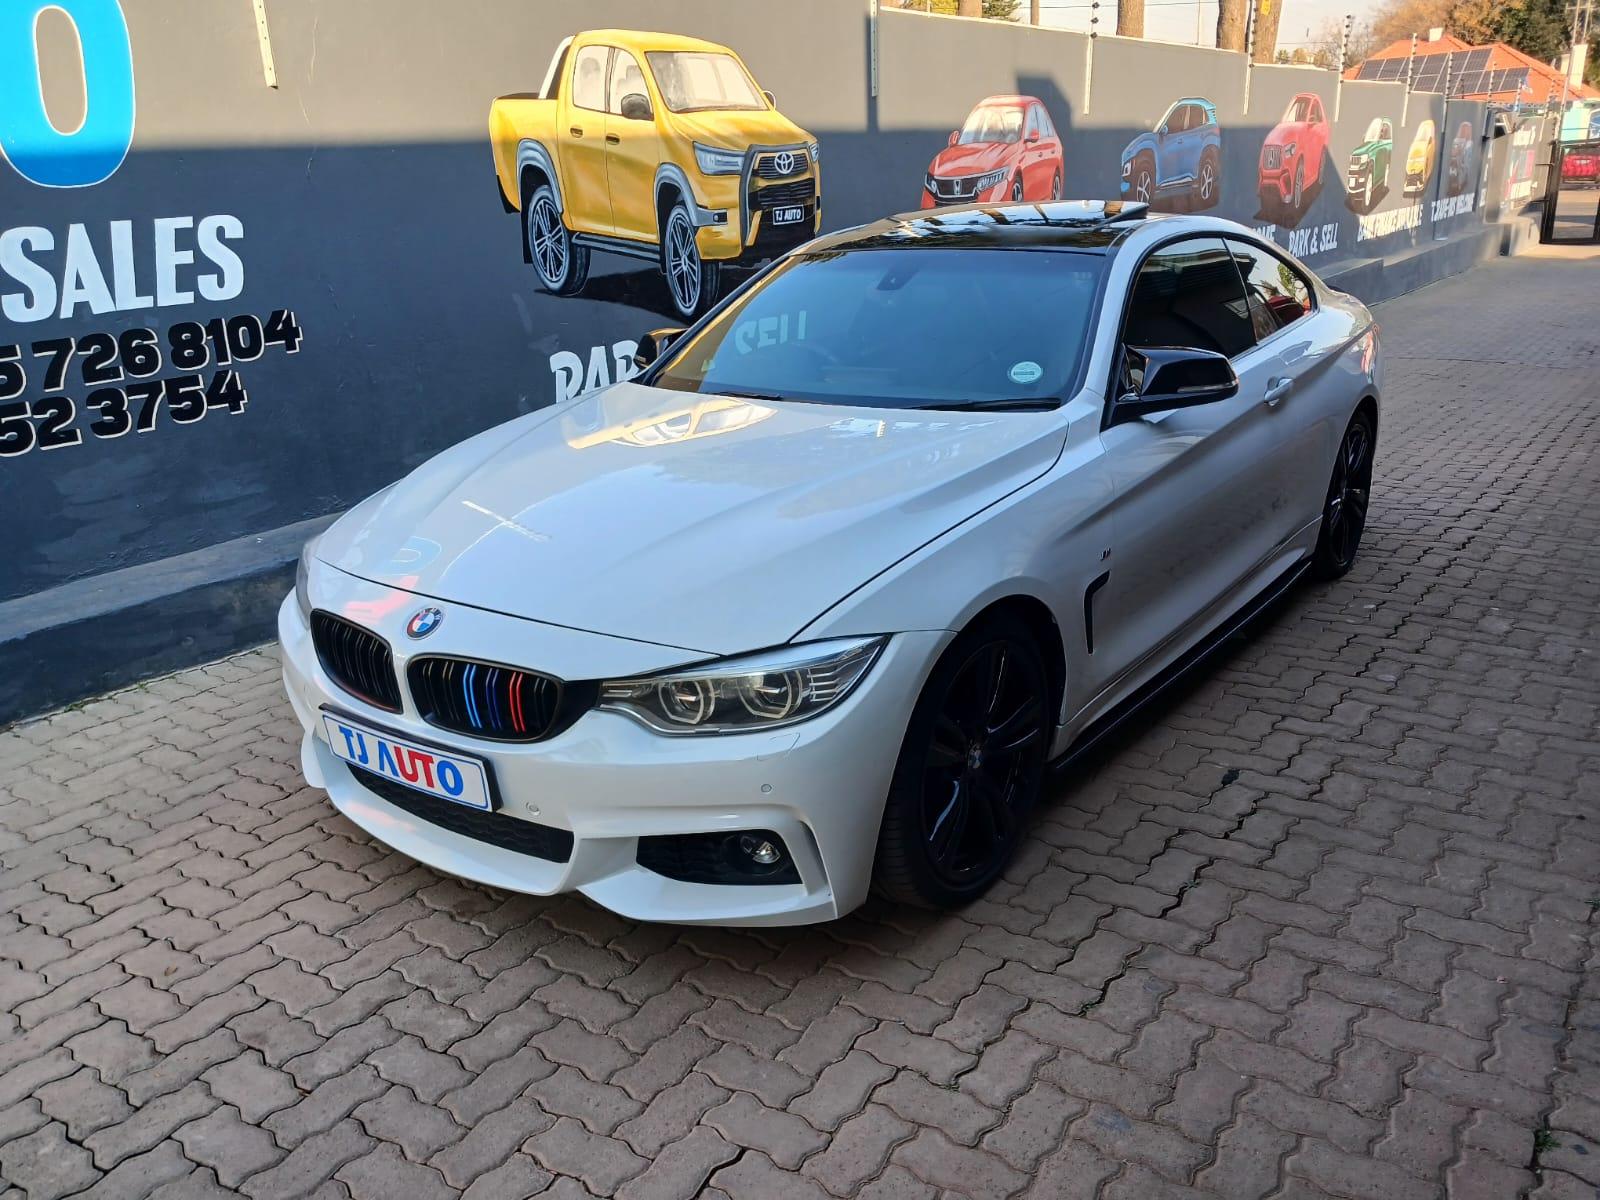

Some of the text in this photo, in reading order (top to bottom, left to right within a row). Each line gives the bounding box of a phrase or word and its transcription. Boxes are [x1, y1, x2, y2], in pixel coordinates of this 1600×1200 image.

[775, 208, 801, 221] TJ AUTO
[1288, 227, 1311, 257] PARK
[1310, 226, 1319, 255] &
[1320, 222, 1339, 252] SELL
[0, 214, 244, 323] SALES
[31, 328, 163, 392] 726
[168, 309, 304, 370] 8104
[86, 369, 249, 439] 3754
[339, 725, 464, 796] TJ AUTO
